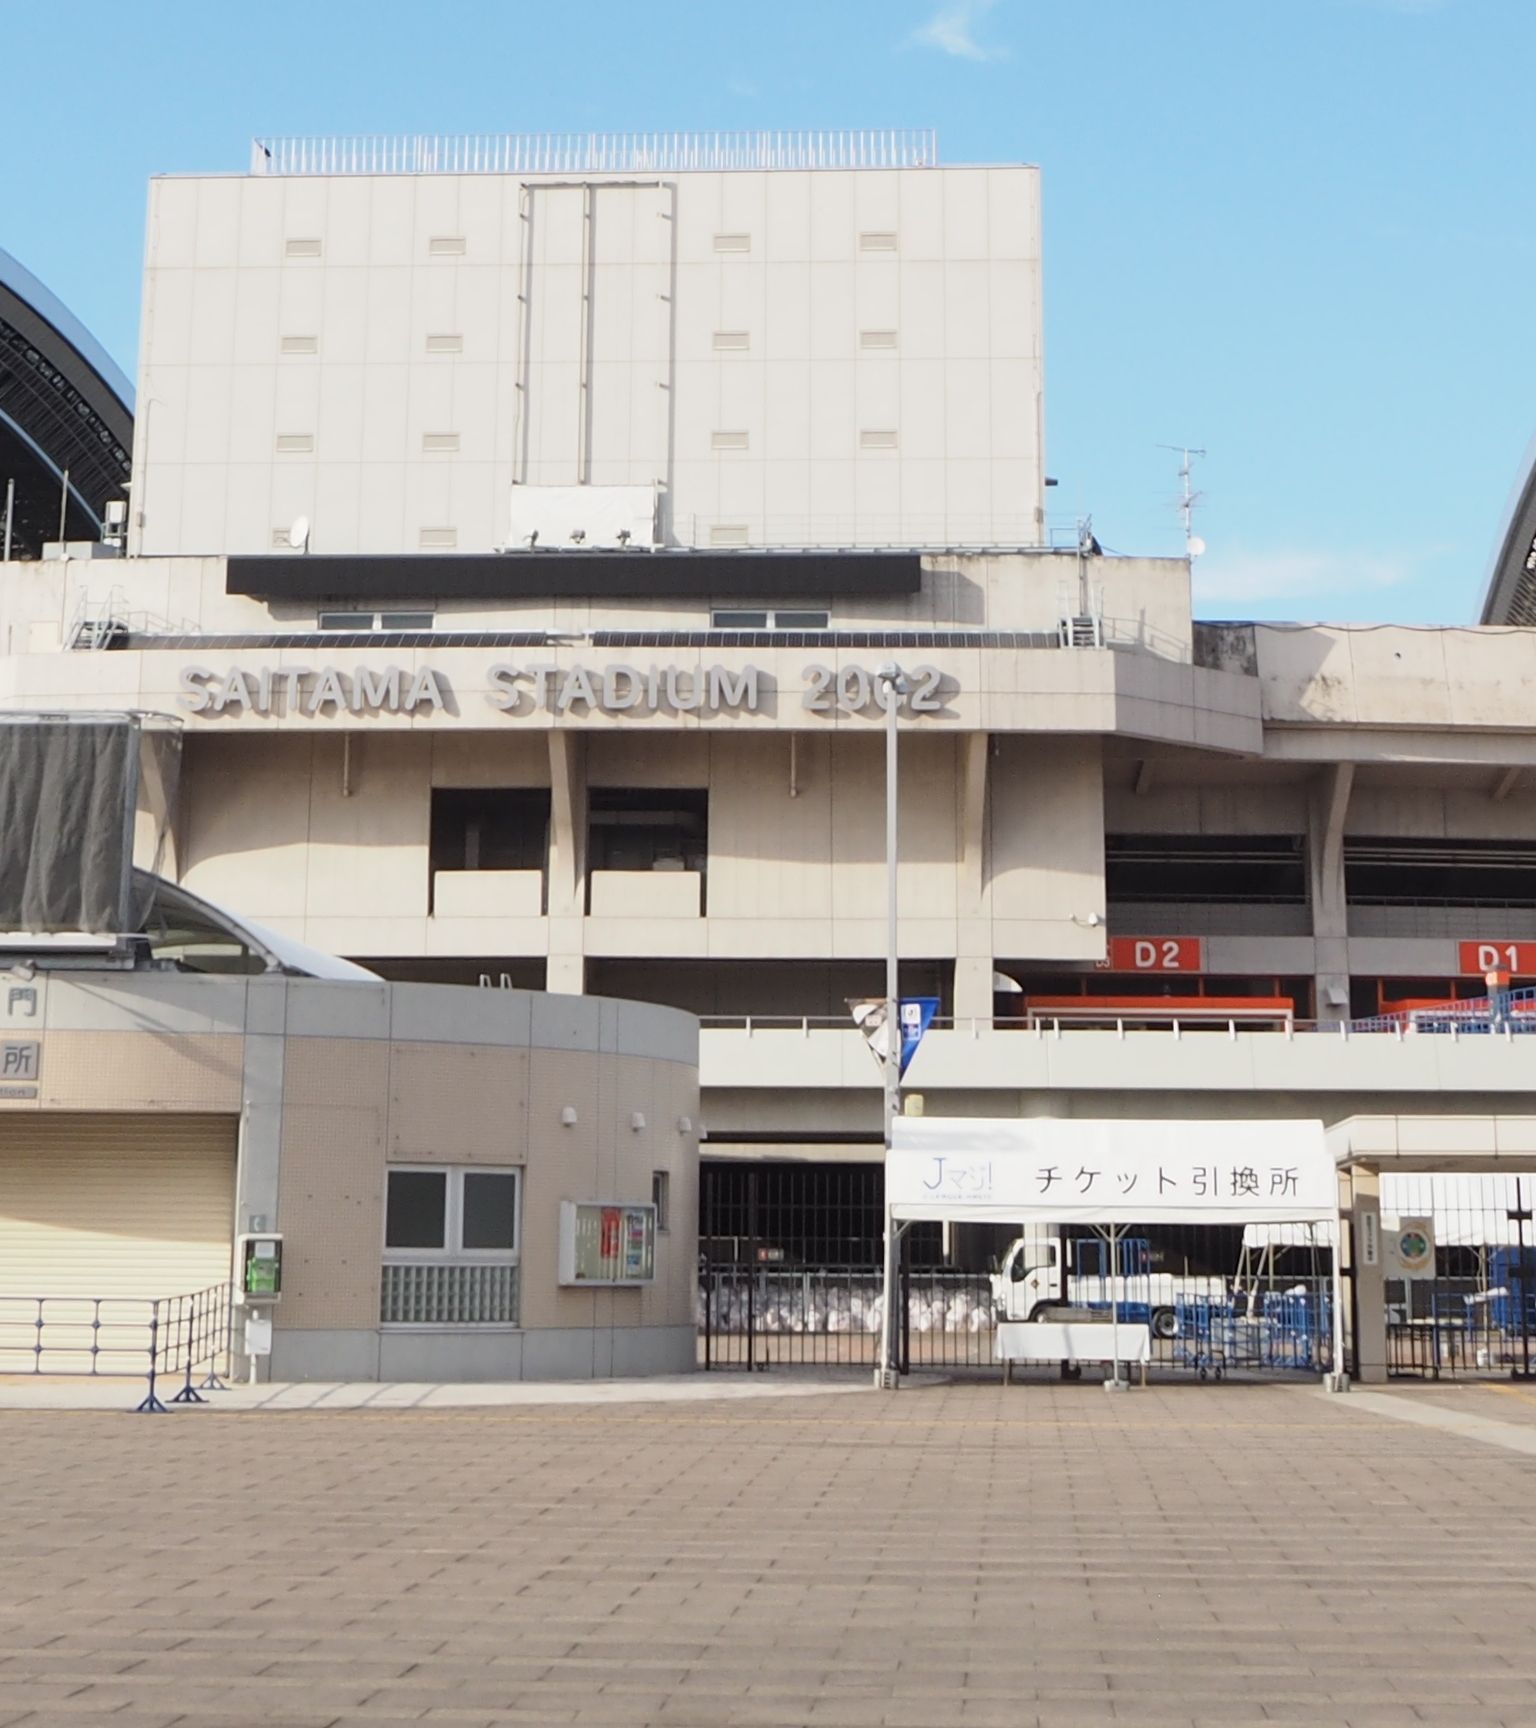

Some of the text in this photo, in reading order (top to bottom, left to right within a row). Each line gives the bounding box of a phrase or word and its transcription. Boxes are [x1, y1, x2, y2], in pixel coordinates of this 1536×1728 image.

[176, 664, 445, 712] SAITAMA
[484, 662, 760, 712] STADIUM
[1135, 940, 1180, 968] D2
[1478, 944, 1518, 973] D1
[1035, 1166, 1300, 1197] チケット引換所
